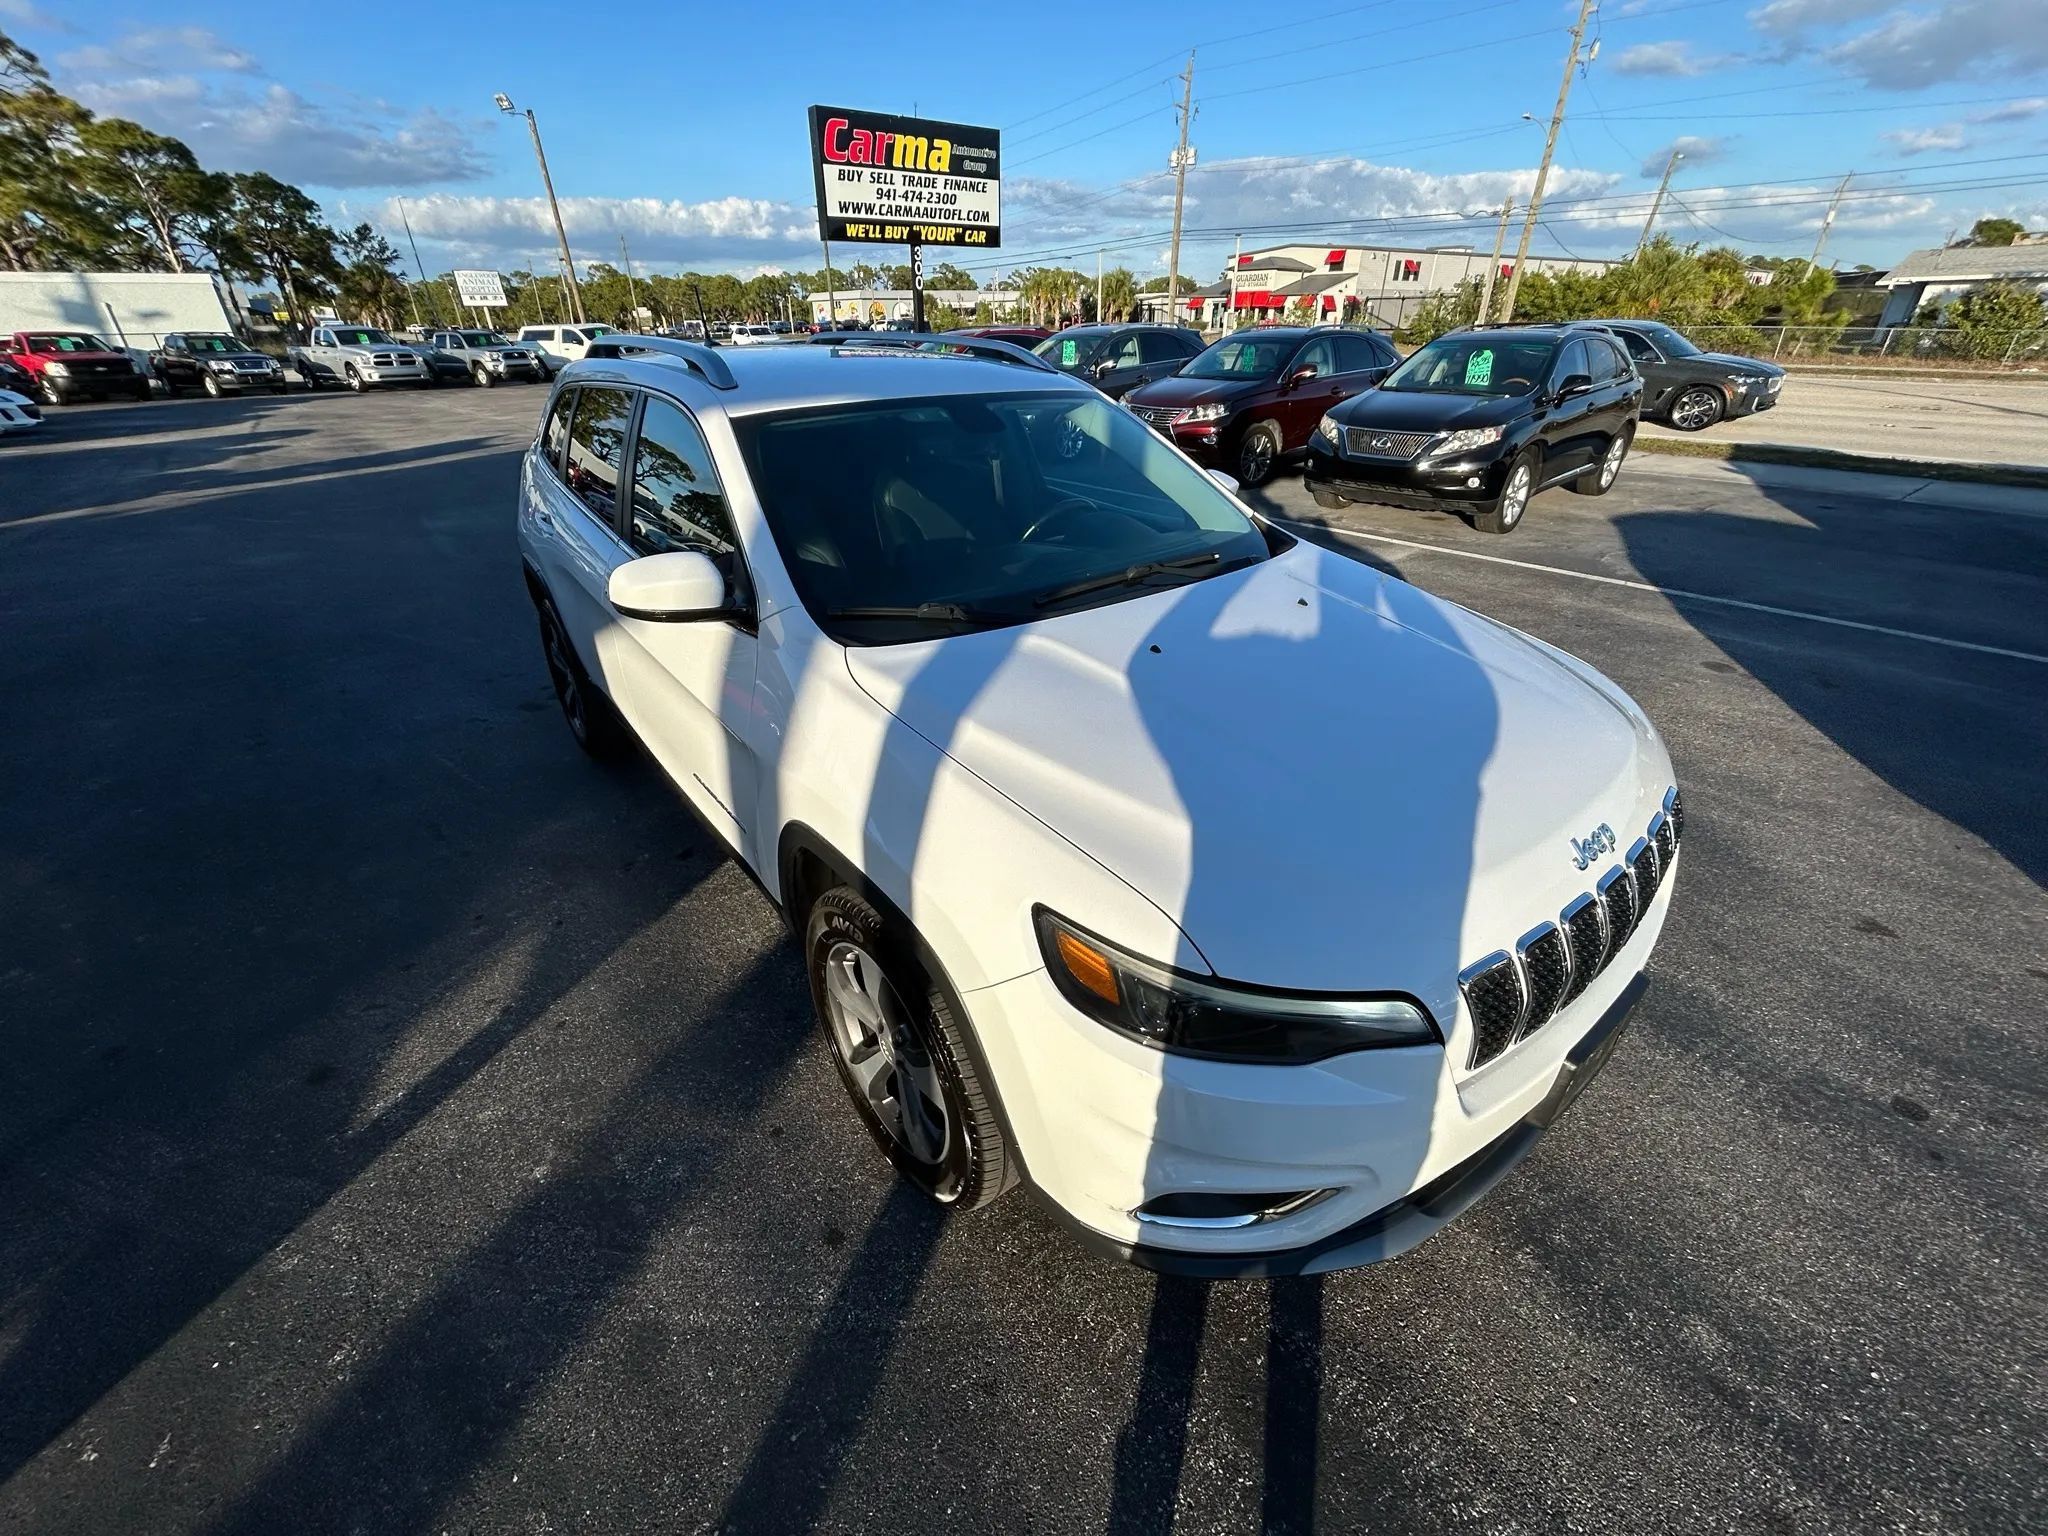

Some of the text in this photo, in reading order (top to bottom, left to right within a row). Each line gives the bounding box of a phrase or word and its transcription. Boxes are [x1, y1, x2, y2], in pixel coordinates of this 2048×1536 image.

[824, 118, 951, 172] Carma
[952, 144, 997, 159] Automotive
[963, 160, 987, 173] Group
[838, 169, 988, 193] BUY SELL TRADE FINANCE
[876, 188, 957, 205] 941-474-2300
[838, 201, 990, 223] WWW.CARMAAUTOFL.COM
[846, 223, 987, 243] WE'LL BUY "YOUR" CAR
[914, 246, 924, 290] 300
[1236, 273, 1269, 282] GUARDIAN
[1569, 822, 1616, 871] Jeep
[832, 916, 863, 943] AVID
